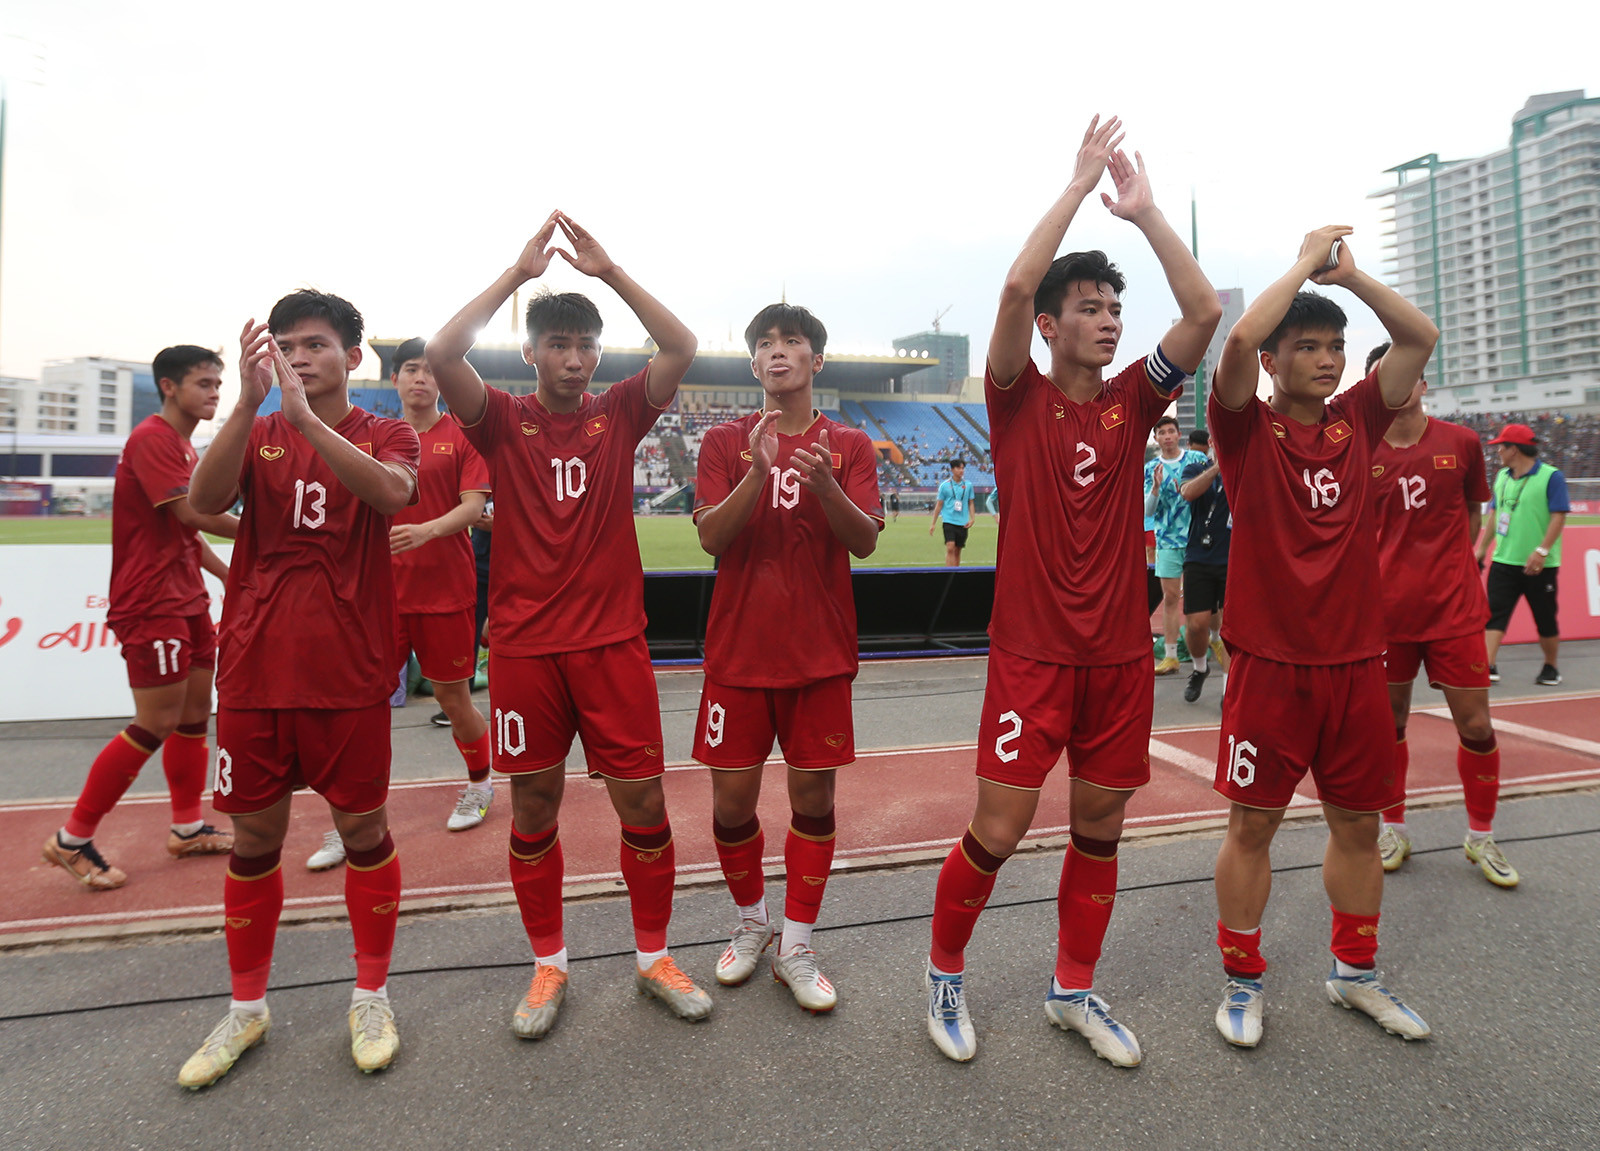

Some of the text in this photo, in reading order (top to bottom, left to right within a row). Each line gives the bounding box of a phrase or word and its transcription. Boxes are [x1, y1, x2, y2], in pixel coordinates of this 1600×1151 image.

[550, 457, 587, 502] 10
[1073, 441, 1097, 487] 2
[293, 479, 327, 530] 13
[770, 466, 800, 510] 19
[1303, 468, 1340, 509] 16
[1398, 475, 1427, 511] 12
[153, 639, 182, 676] 17
[495, 708, 527, 757] 10
[995, 711, 1022, 764] 2
[1226, 735, 1258, 788] 16
